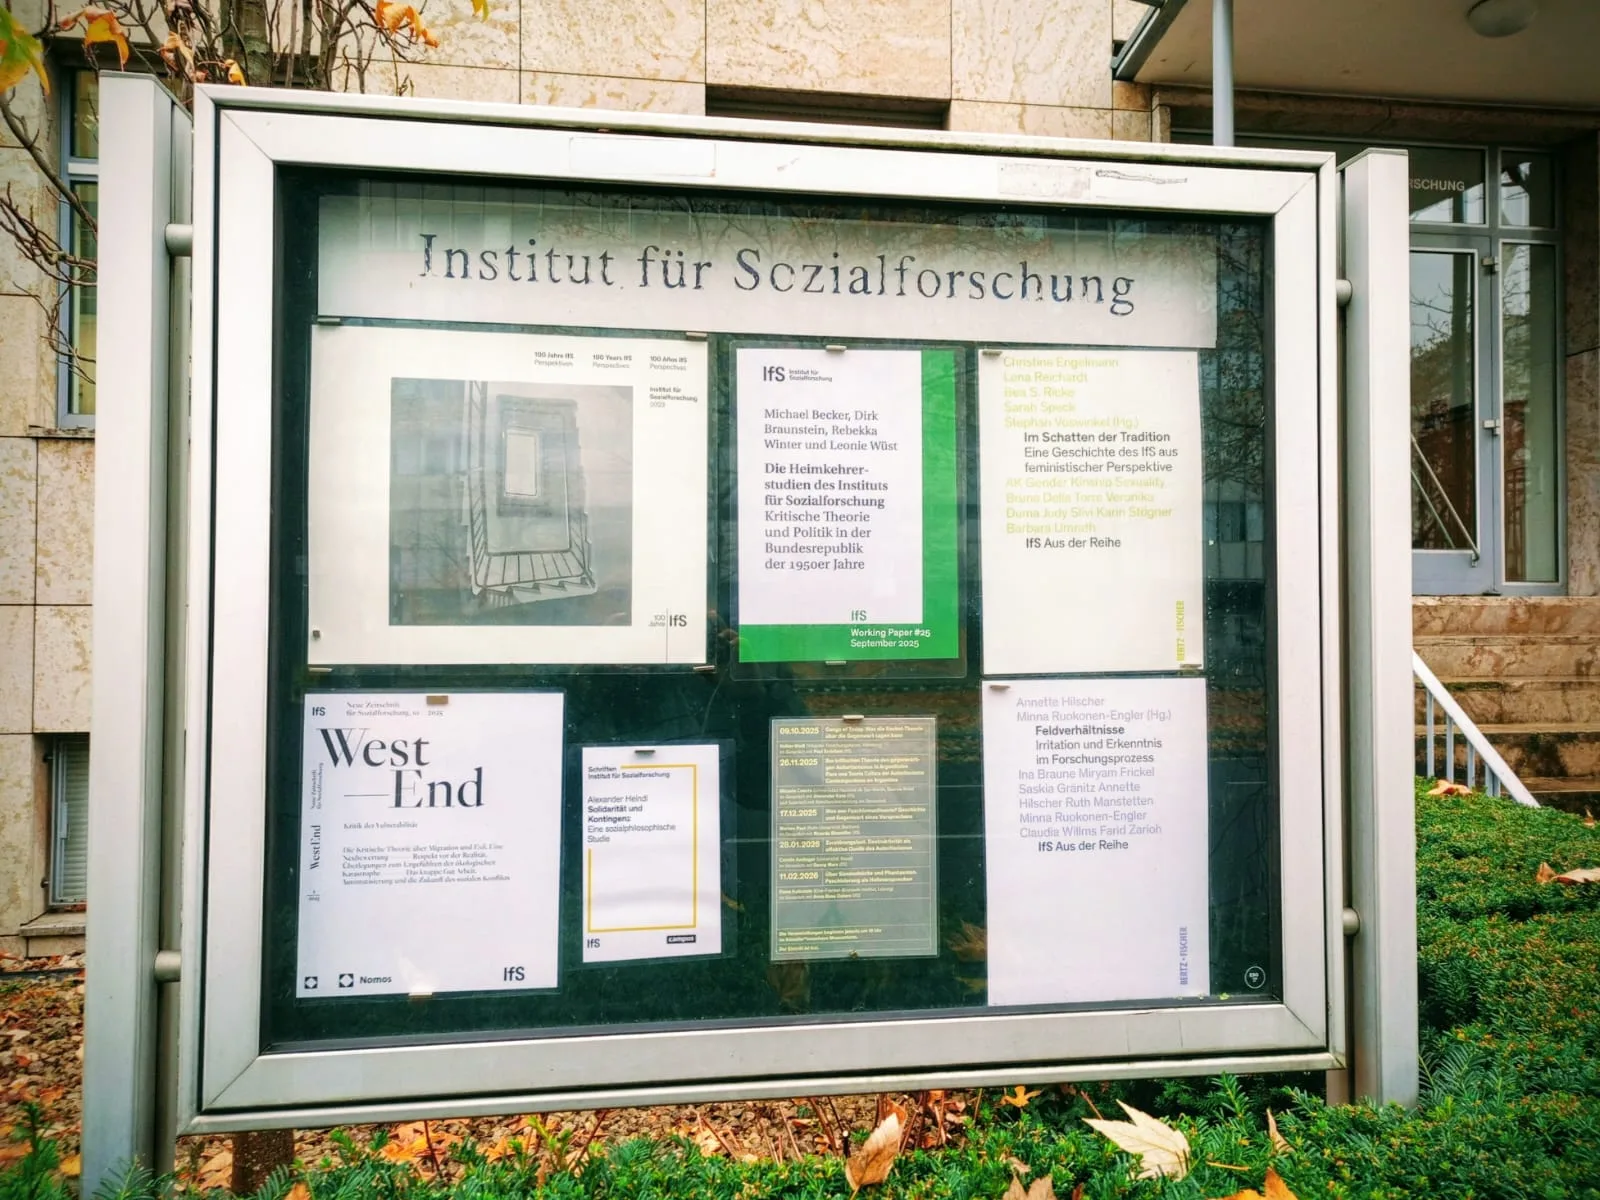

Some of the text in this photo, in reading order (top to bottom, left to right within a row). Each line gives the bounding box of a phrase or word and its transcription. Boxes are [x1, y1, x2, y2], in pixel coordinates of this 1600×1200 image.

[418, 233, 1136, 316] Institut für Sozialforschung
[763, 366, 786, 382] IfS
[1004, 402, 1036, 412] Sarah
[764, 408, 879, 421] Michael Becker, Dirk
[764, 424, 878, 436] Braunstein, Rebekka
[1024, 432, 1170, 442] Im Schatten der Tradition
[764, 439, 898, 451] Winter und Leonie Wüst
[1024, 447, 1178, 458] Eine Geschichte des IfS aus
[764, 462, 869, 475] Die Heimkehrer-
[1024, 462, 1173, 474] feministischer Perspektive
[764, 479, 888, 491] studien des Instituts
[764, 494, 885, 509] für Sozialforschung
[765, 511, 870, 522] Kritische Theorie
[765, 526, 872, 538] und Politik in der
[1026, 537, 1121, 548] IfS Aus der Reihe
[765, 542, 864, 556] Bundesrepublik
[765, 558, 865, 570] der 1950er Jahre
[669, 614, 687, 627] IfS
[851, 610, 867, 621] IfS
[851, 629, 931, 638] Working Paper #25
[851, 639, 920, 648] September 2025
[1016, 697, 1105, 708] Annette Hilscher
[312, 707, 326, 716] IfS
[1017, 710, 1171, 722] Minna Ruokonen-Engler (Hg.)
[1036, 725, 1125, 736] Feldverhältnisse
[316, 728, 430, 768] West
[1036, 738, 1162, 750] Irritation und Erkenntnis
[1036, 754, 1154, 765] im Forschungsprozess
[1018, 767, 1155, 781] Ina Braune Miryam Frickel
[388, 766, 486, 808] End
[1019, 782, 1141, 794] Saskia Annette
[1019, 796, 1154, 809] Hilscher Ruth Manstetten
[588, 805, 627, 813] Solidarität
[588, 815, 631, 824] Kontingenz
[1020, 811, 1147, 823] Minna Ruokonen-Engler
[605, 824, 676, 833] sozialphilosophische
[1020, 825, 1126, 838] Claudia Willms Farid
[309, 825, 320, 870] WestEnd
[1038, 840, 1128, 852] IfS Aus der Reihe
[587, 939, 600, 948] IfS
[503, 966, 525, 981] IfS
[359, 976, 392, 984] Nomos
